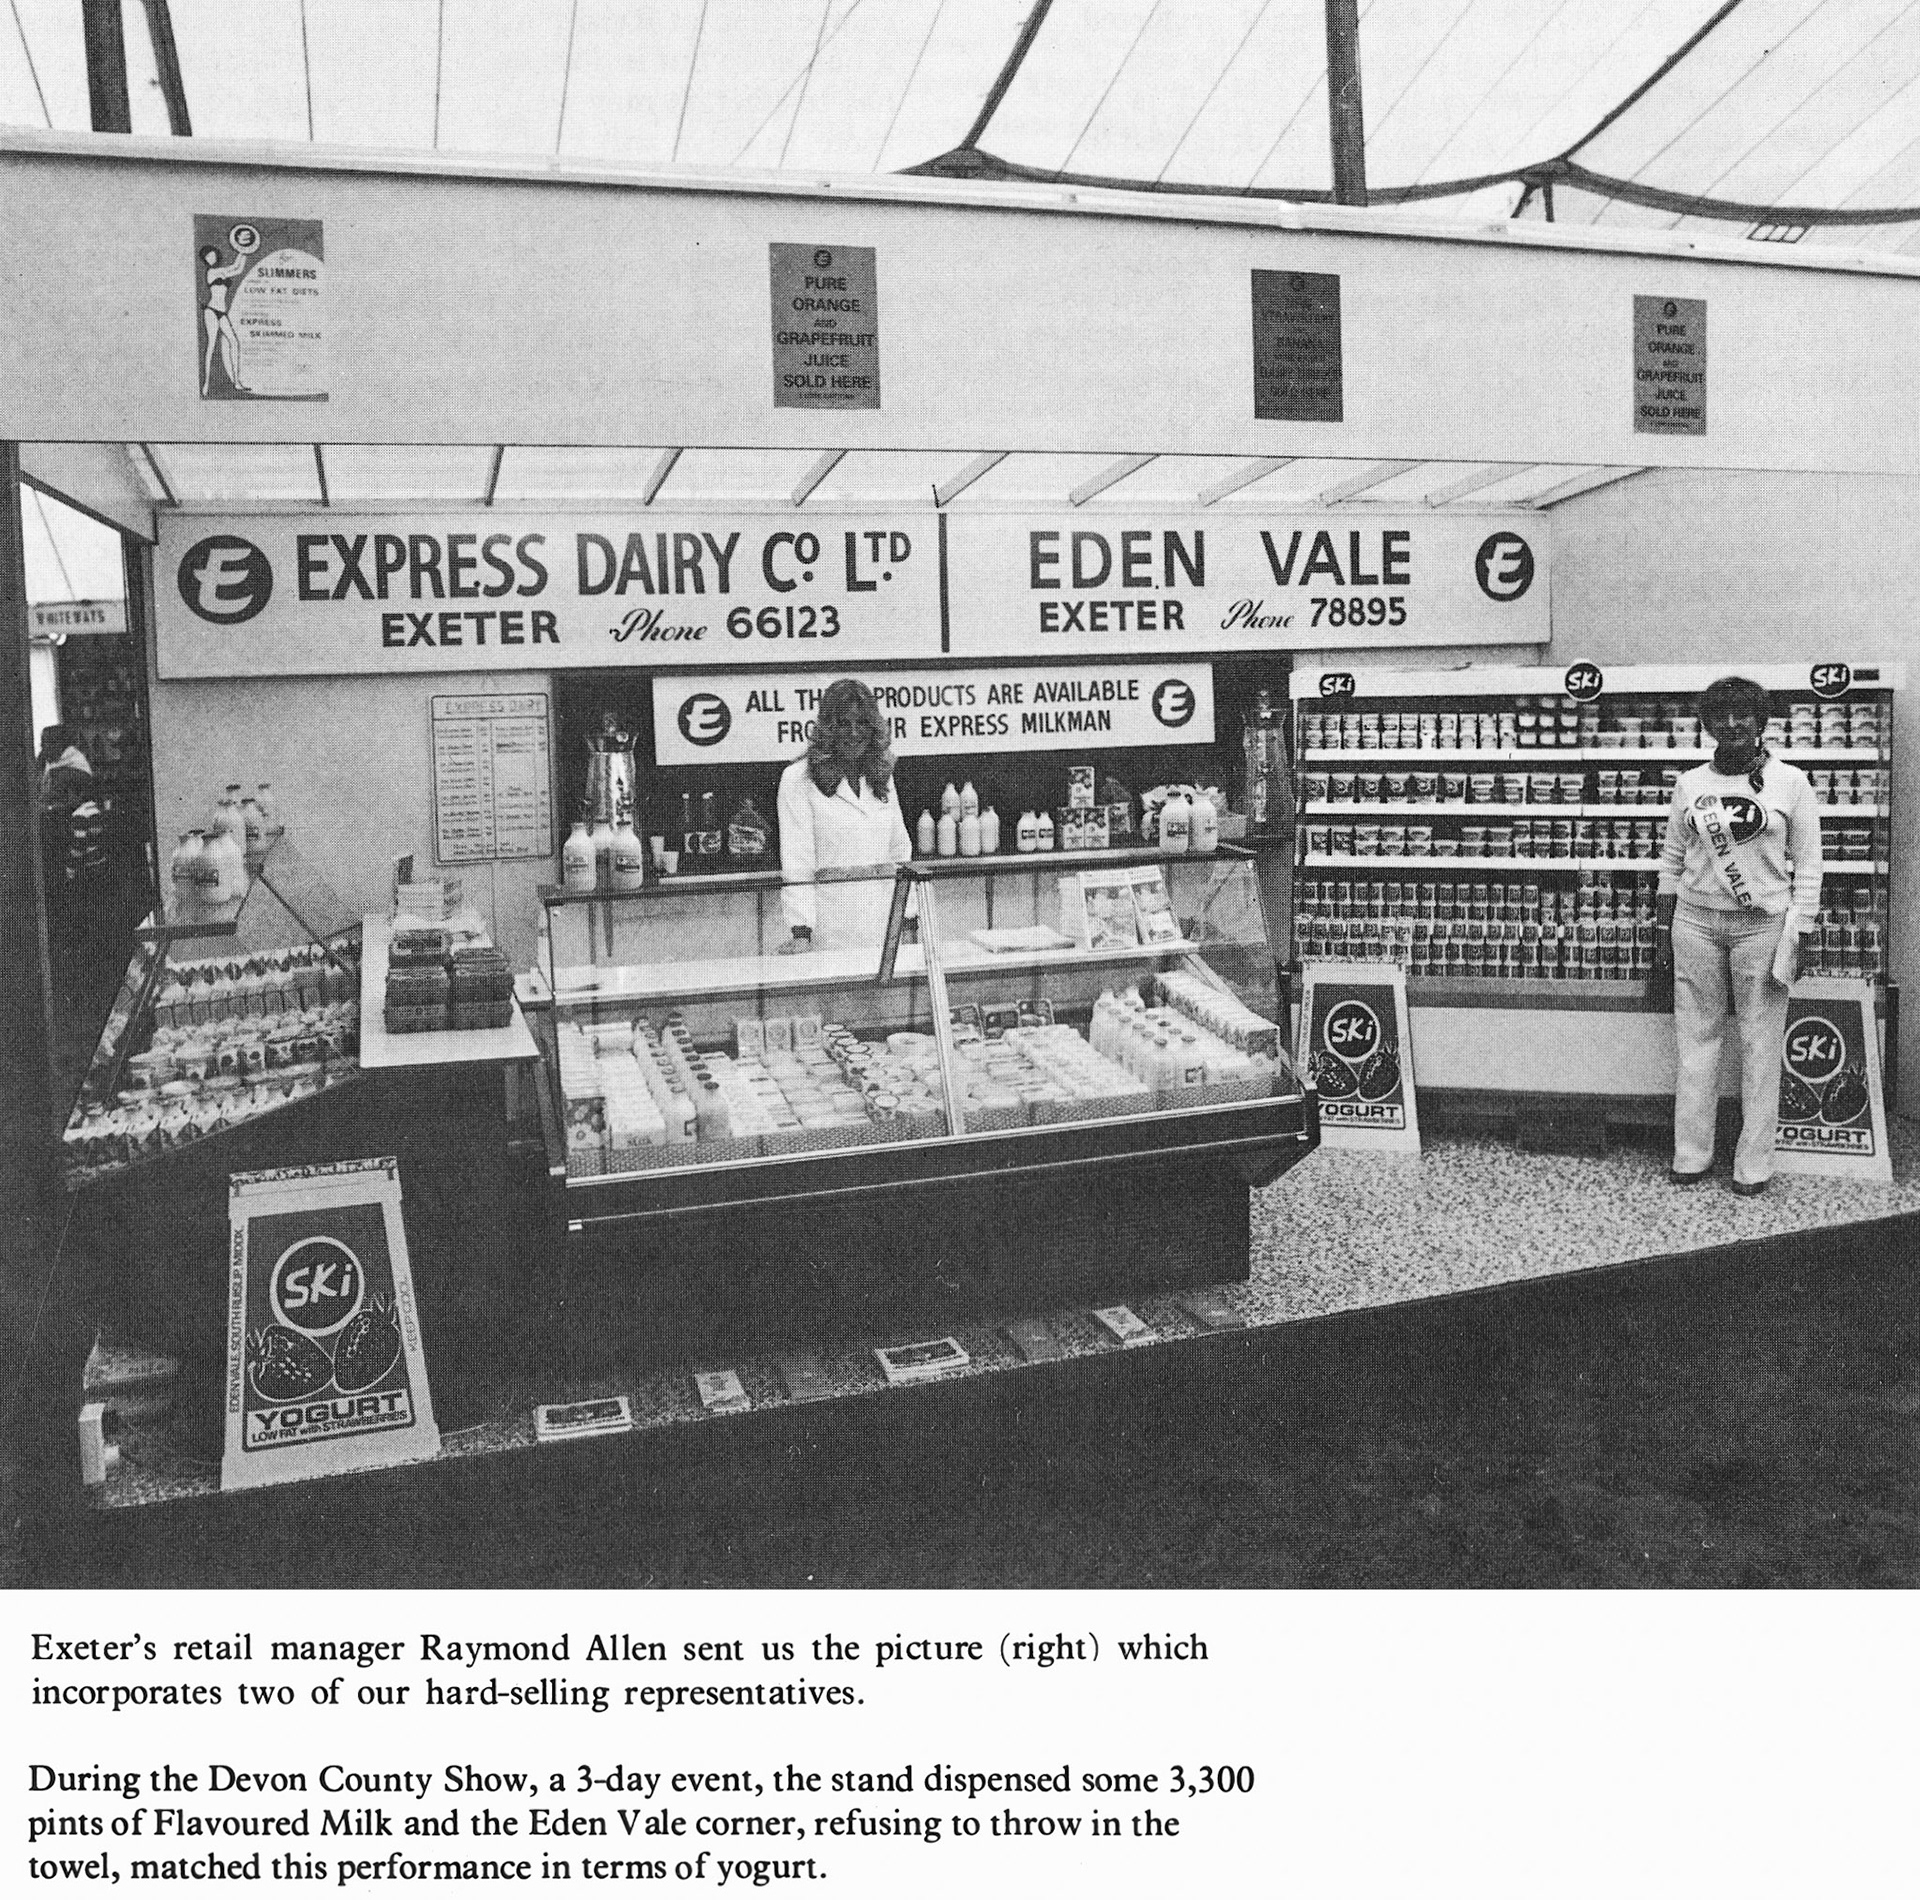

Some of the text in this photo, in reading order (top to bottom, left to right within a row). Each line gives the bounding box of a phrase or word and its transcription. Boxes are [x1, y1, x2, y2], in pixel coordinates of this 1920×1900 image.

[257, 267, 317, 280] SLIMMERS
[270, 287, 287, 295] FAT
[804, 276, 847, 291] PURE
[792, 297, 861, 312] ORANGE
[240, 318, 282, 327] EXPRESS
[1656, 323, 1686, 337] PURE
[776, 331, 875, 347] GRAPEFRUIT
[1647, 341, 1695, 355] ORANGE
[803, 354, 851, 368] JUICE
[783, 374, 873, 389] SOLD HERE
[1637, 368, 1704, 384] GRAPEFRUIT
[1655, 388, 1687, 401] JUICE
[1640, 405, 1701, 420] SOLD HERE
[296, 532, 549, 601] EXPRESS
[576, 531, 741, 596] DAIRY
[1029, 530, 1411, 590] EDEN VALE
[1040, 597, 1408, 633] EXETER Phone 78895
[382, 604, 841, 647] EXETER Phone 66123
[745, 690, 785, 712] ALL
[873, 679, 1140, 709] PRODUCTS ARE AVAILABLE
[777, 720, 815, 743] FRO
[921, 713, 1009, 737] EXPRESS
[1021, 710, 1111, 734] MILKMAN
[1703, 812, 1732, 857] EDEN
[1724, 862, 1752, 909] VALE
[1777, 1125, 1867, 1144] OGURT
[399, 1274, 417, 1353] KEEP COOL
[230, 1311, 242, 1350] SOUTH
[255, 1392, 403, 1431] YOGURT
[252, 1410, 408, 1443] LOW FAT with STRAWBERRIES
